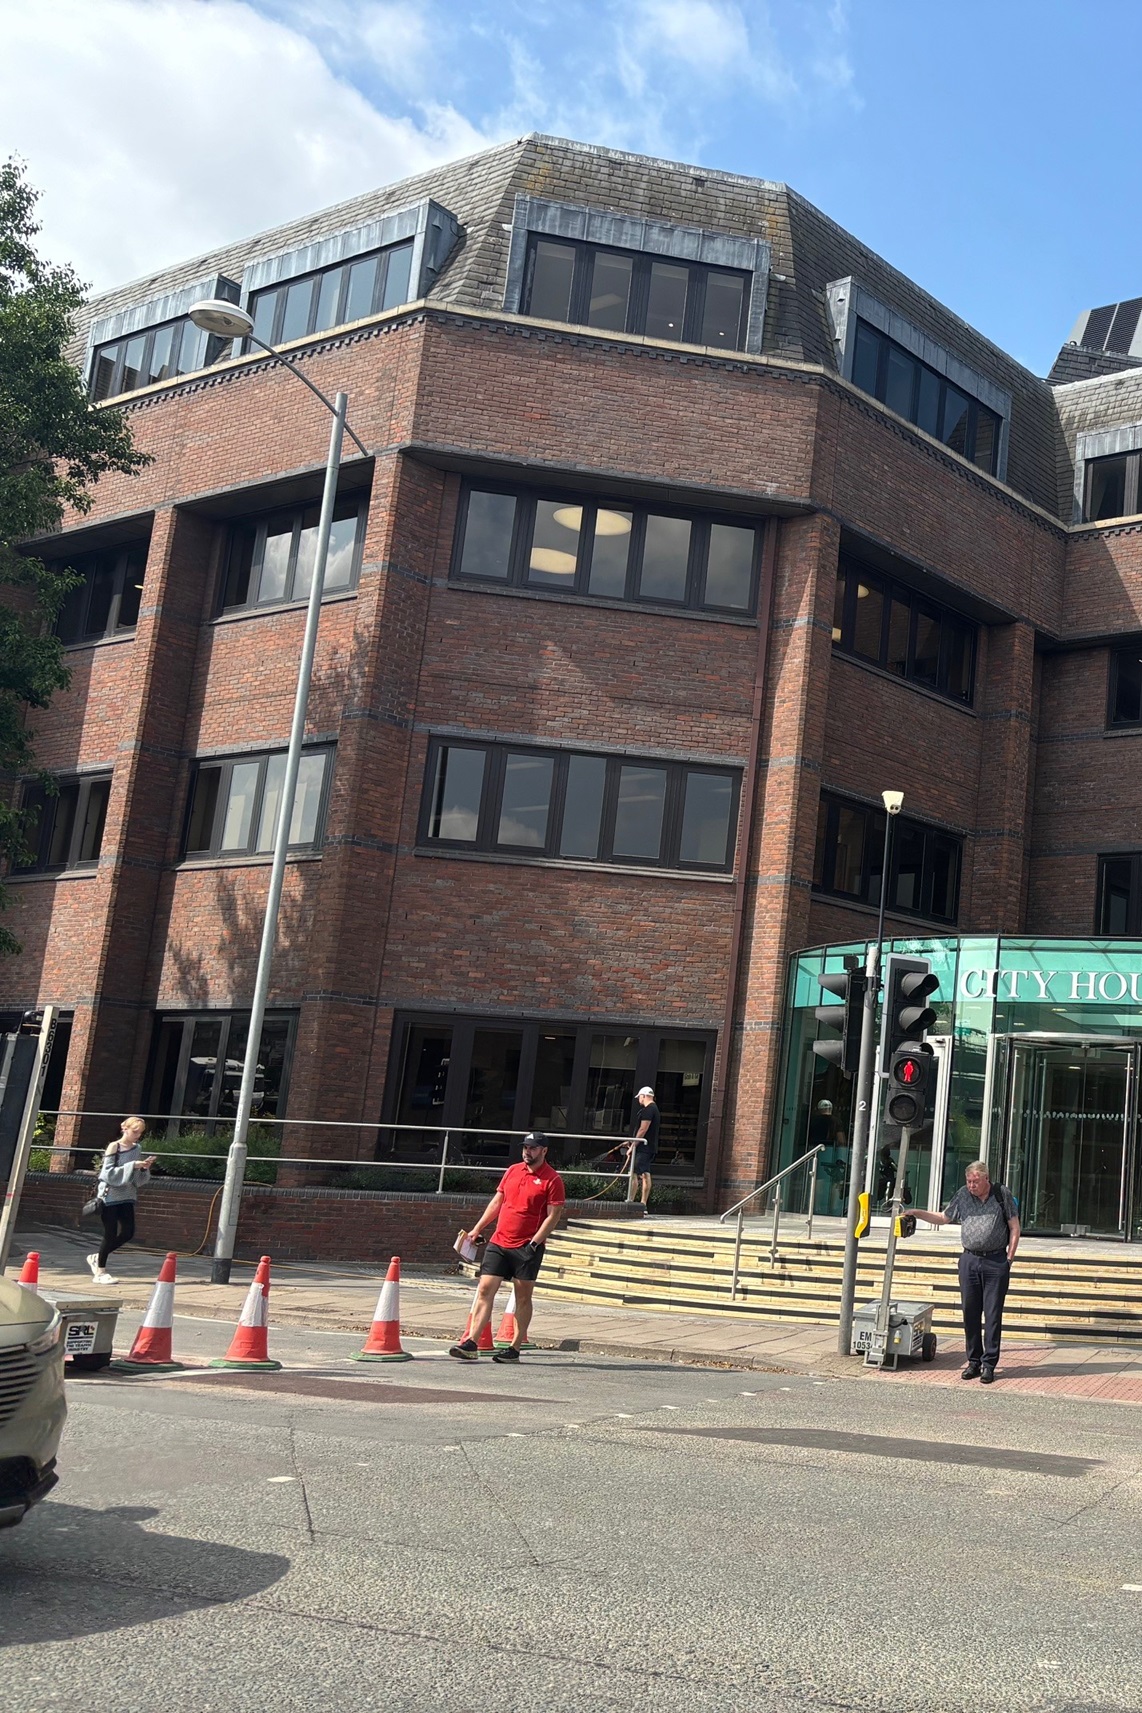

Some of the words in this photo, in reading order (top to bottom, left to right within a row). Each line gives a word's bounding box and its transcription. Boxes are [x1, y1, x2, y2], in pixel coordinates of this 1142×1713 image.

[960, 968, 1058, 999] CITY
[858, 1100, 867, 1111] 2
[68, 1325, 94, 1336] SRL
[860, 1331, 873, 1341] EM
